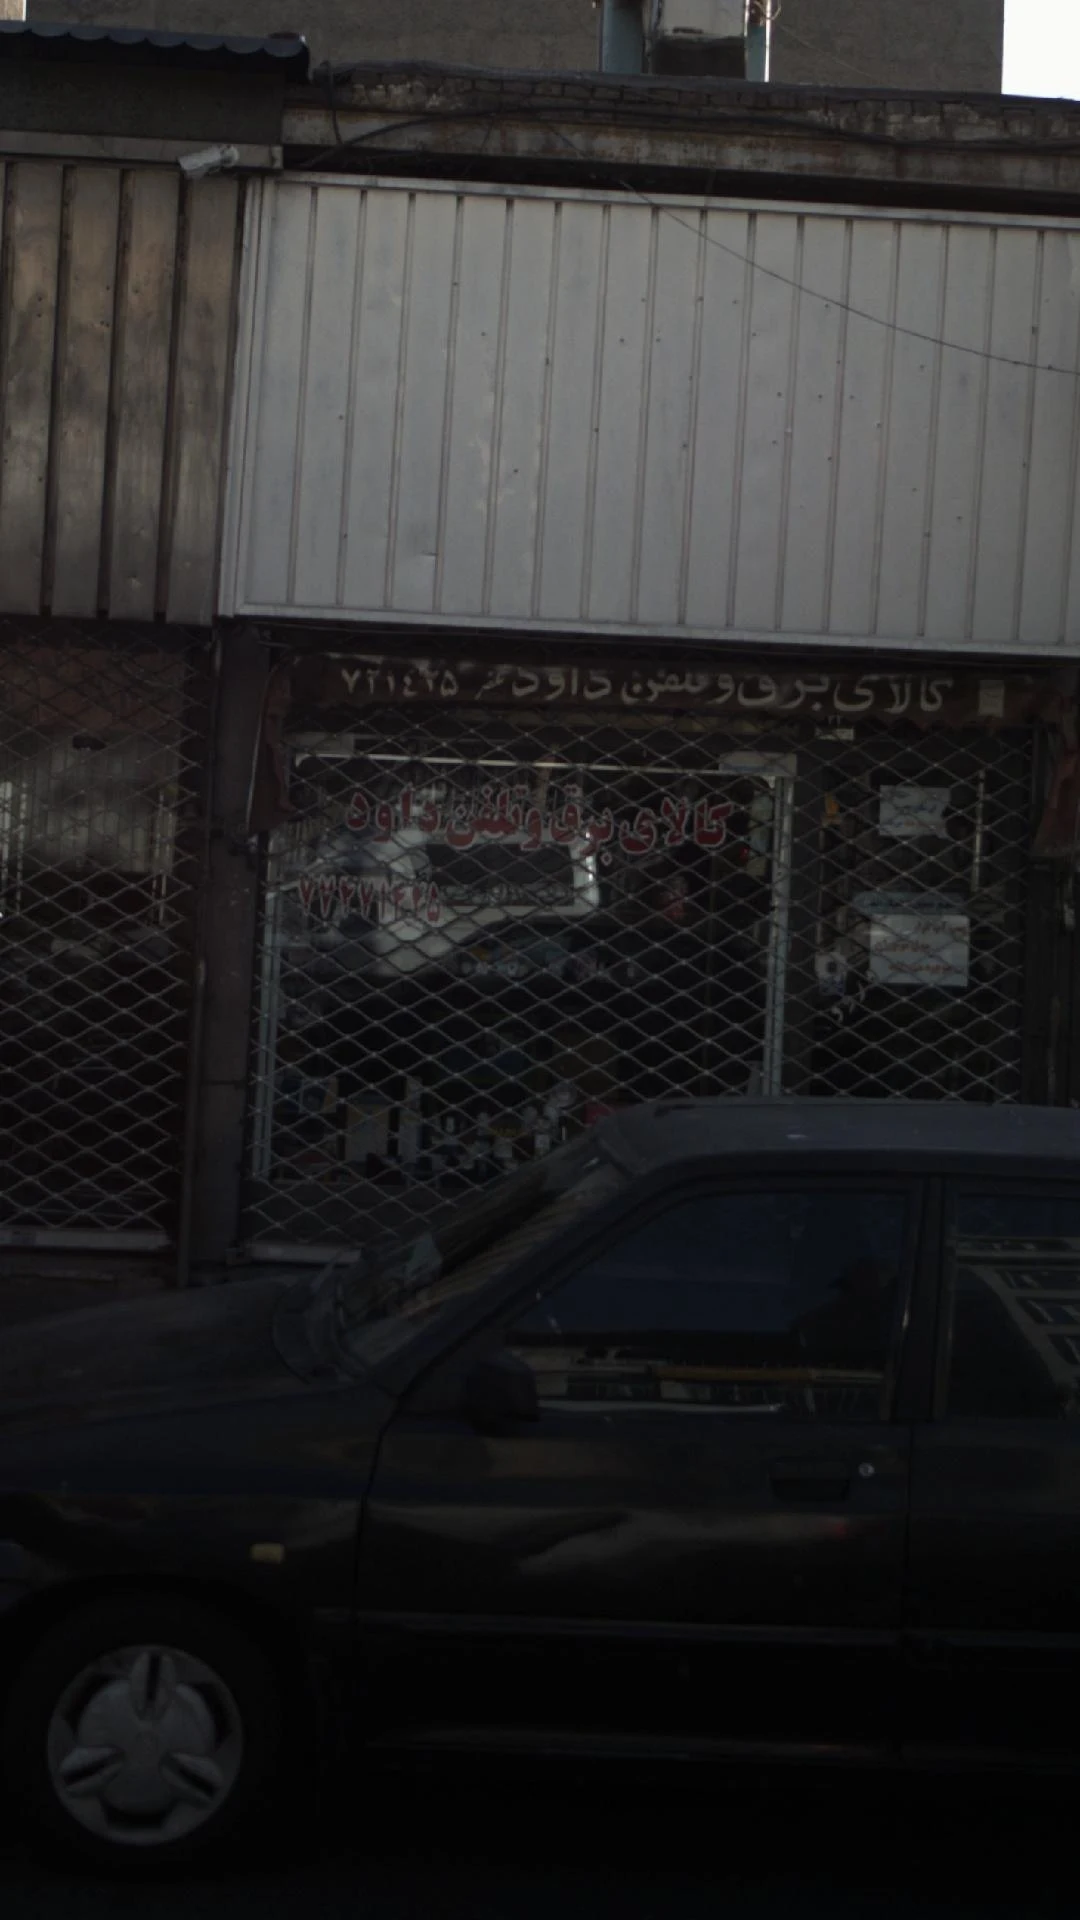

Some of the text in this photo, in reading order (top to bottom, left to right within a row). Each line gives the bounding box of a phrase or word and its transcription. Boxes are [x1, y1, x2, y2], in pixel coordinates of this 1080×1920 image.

[511, 666, 613, 702] داود
[834, 672, 955, 716] کالای
[345, 783, 441, 844] داود
[549, 783, 615, 867] برق
[618, 796, 735, 856] کالای
